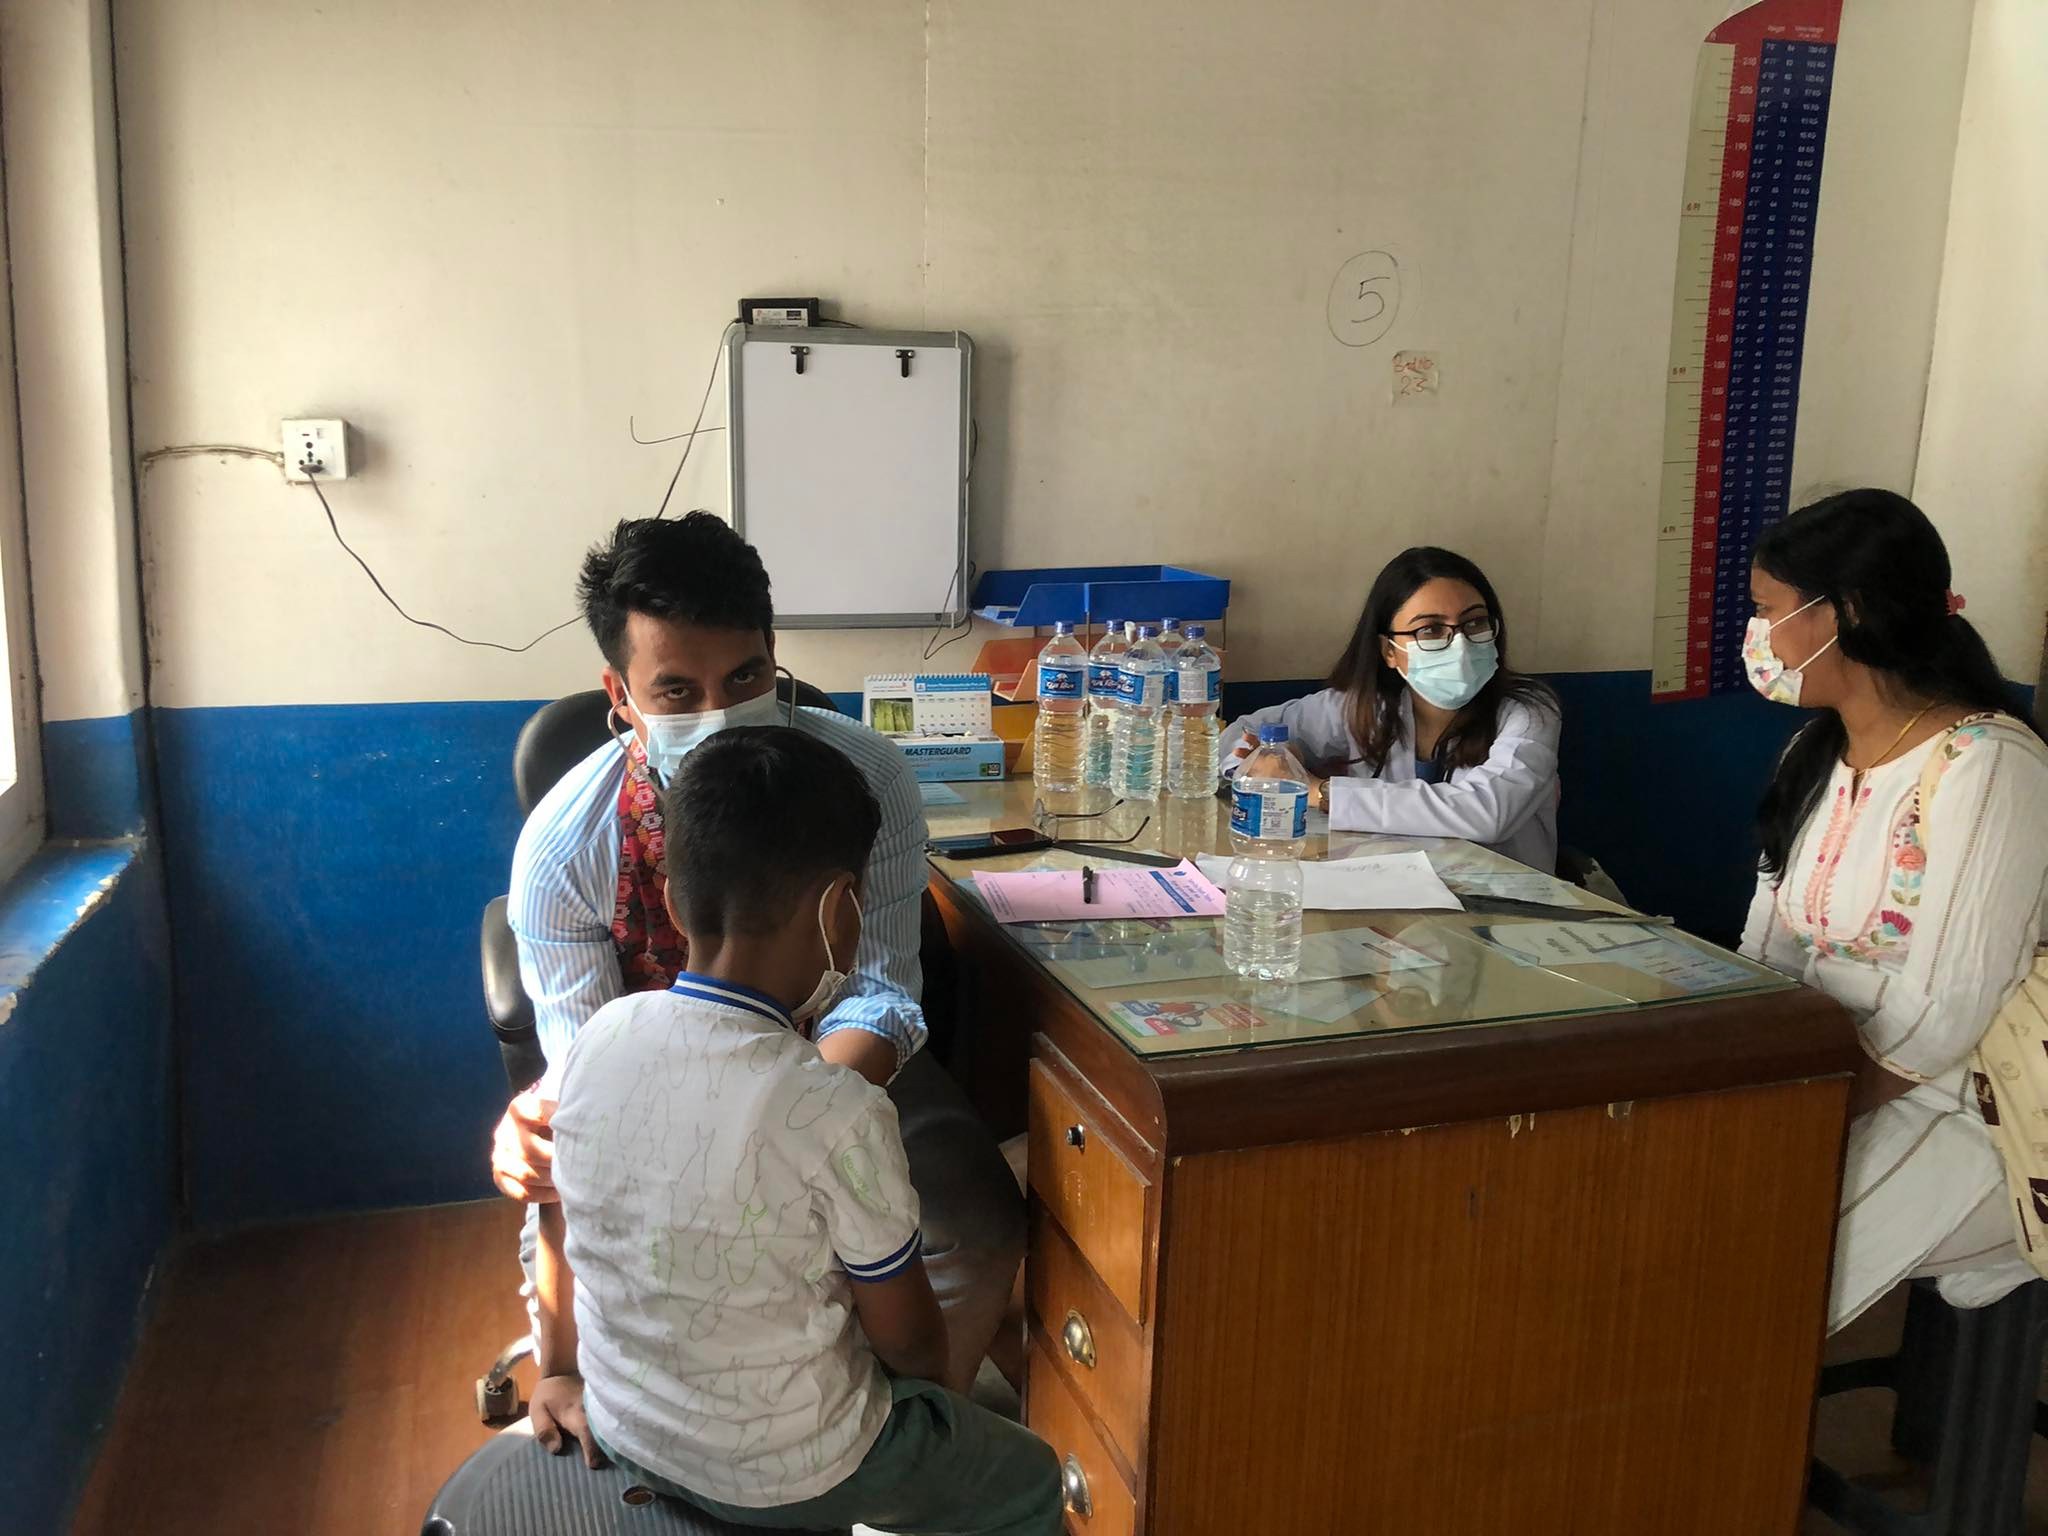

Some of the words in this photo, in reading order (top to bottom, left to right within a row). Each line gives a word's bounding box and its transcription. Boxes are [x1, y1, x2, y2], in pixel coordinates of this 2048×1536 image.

[1735, 142, 1747, 151] 195
[1732, 171, 1745, 180] 190
[1726, 226, 1739, 235] 180
[1722, 253, 1736, 261] 175
[1351, 276, 1391, 324] 5
[1400, 376, 1428, 395] 23
[905, 747, 971, 756] MASTERGUARD
